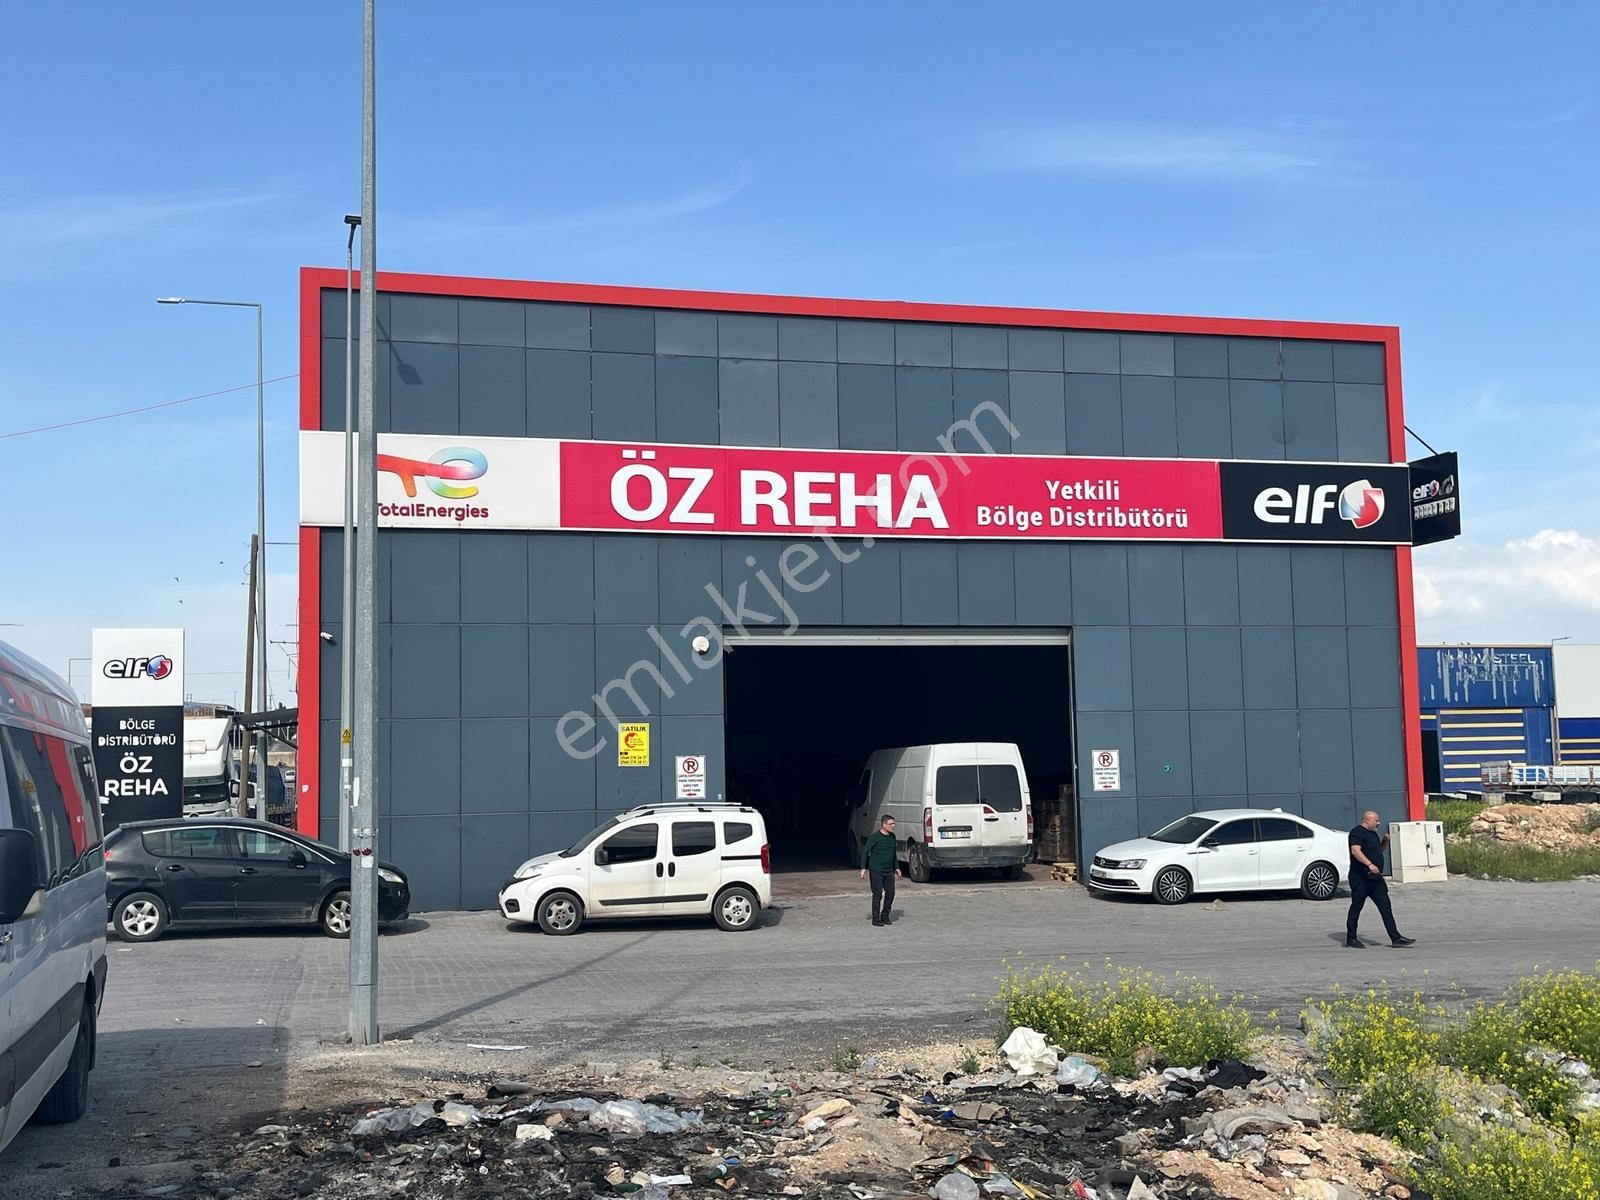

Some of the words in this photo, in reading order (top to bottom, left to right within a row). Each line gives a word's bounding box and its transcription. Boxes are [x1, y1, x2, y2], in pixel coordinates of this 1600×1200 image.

[610, 449, 715, 524] ÖZ
[740, 469, 950, 529] REHA
[1045, 480, 1120, 501] Yetkili
[376, 502, 489, 521] TotalEnergies
[1253, 483, 1338, 525] elf
[976, 505, 1043, 532] Bölge
[1049, 506, 1189, 529] Distribütörü
[102, 657, 150, 679] elf
[119, 717, 156, 730] BÖLGE
[98, 733, 176, 747] DİSTRİBÜTÖRÜ
[119, 752, 153, 774] ÖZ
[104, 778, 169, 797] REHA
